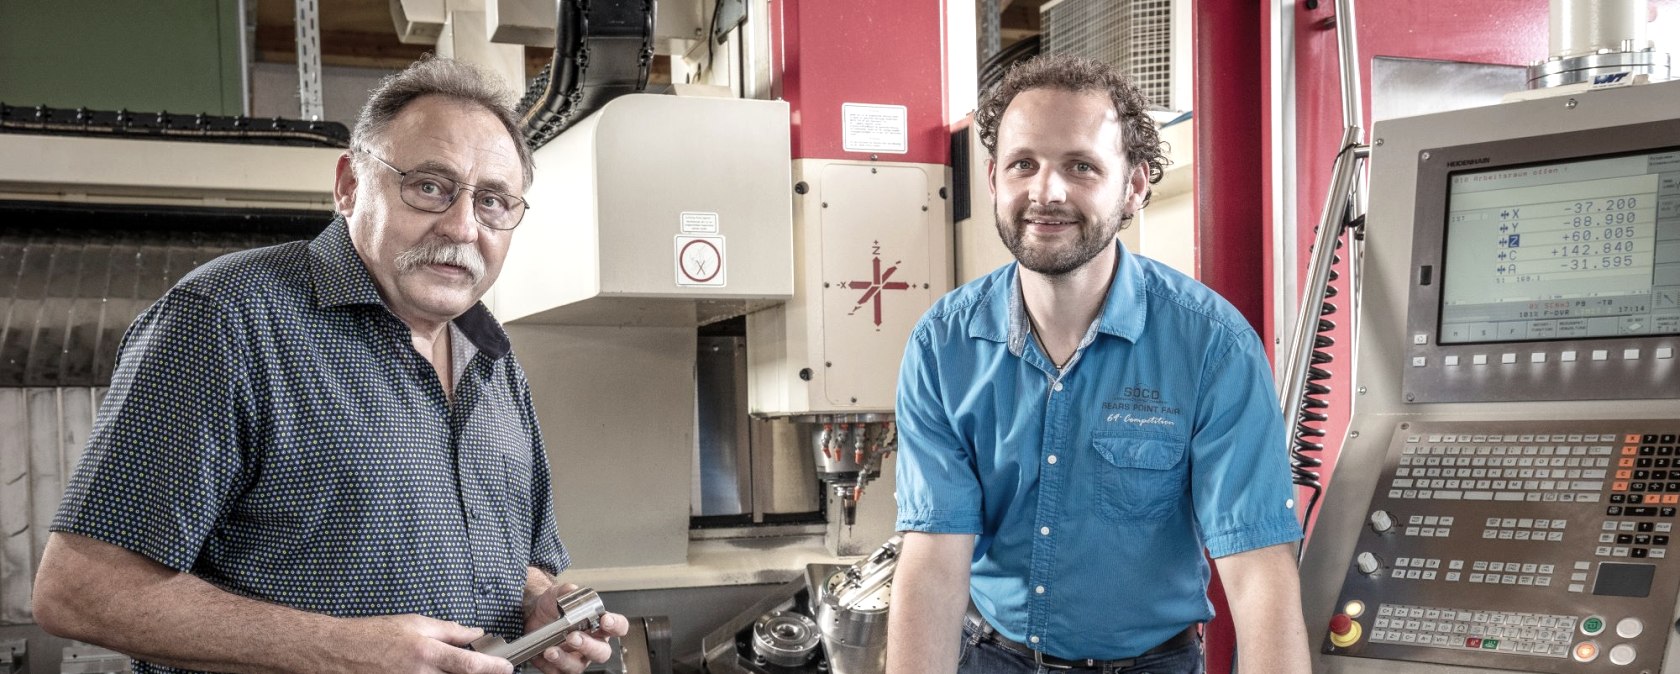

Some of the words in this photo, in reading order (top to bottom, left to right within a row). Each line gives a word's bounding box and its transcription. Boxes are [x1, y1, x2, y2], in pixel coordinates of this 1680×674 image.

[1564, 197, 1637, 214] -37.200
[1563, 212, 1636, 228] -88.990
[1562, 226, 1635, 242] +60.005
[1551, 241, 1634, 257] +142.840
[1561, 255, 1633, 271] -31.595
[1133, 403, 1158, 413] POINT
